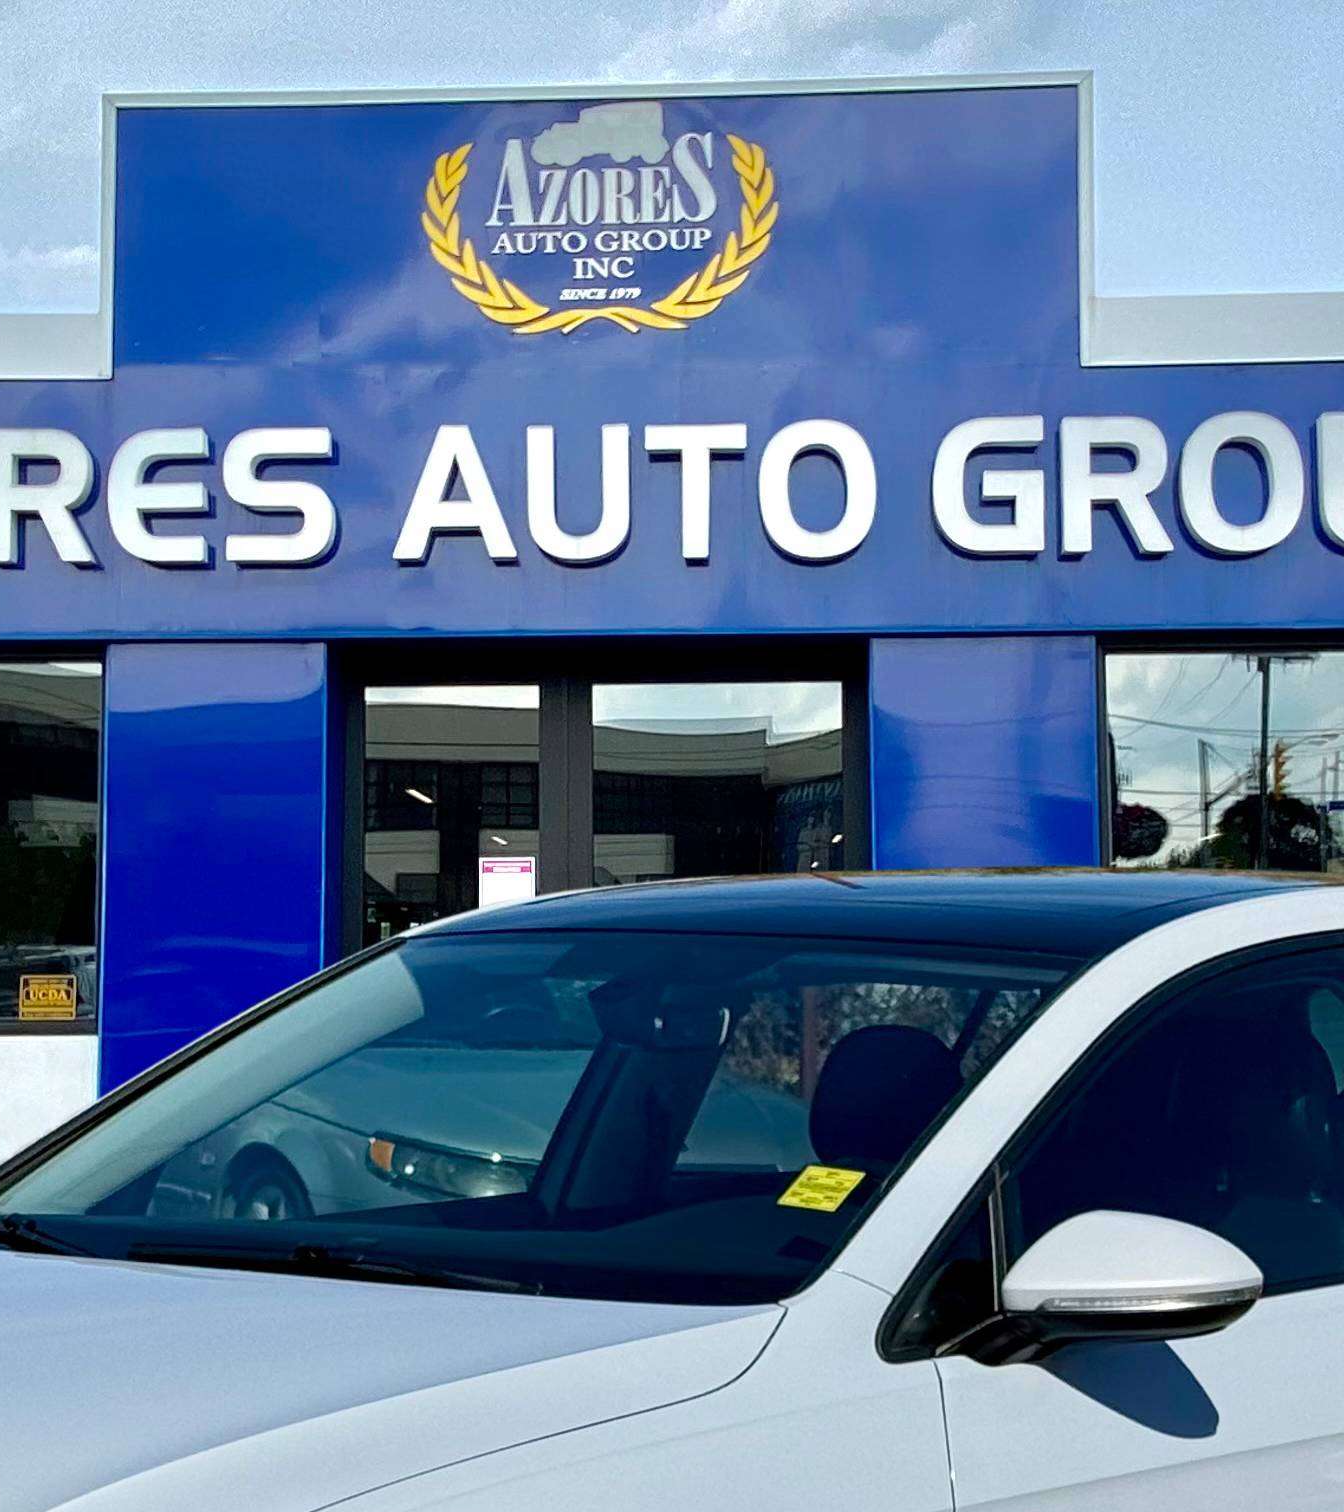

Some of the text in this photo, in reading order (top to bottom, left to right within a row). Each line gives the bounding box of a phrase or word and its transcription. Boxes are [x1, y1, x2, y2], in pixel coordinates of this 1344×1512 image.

[485, 132, 717, 227] AZORES
[491, 229, 712, 255] AUTO GROUP
[573, 257, 635, 279] INC
[559, 288, 608, 300] SINCE
[393, 418, 877, 566] AUTO
[29, 989, 68, 1001] UCDA
